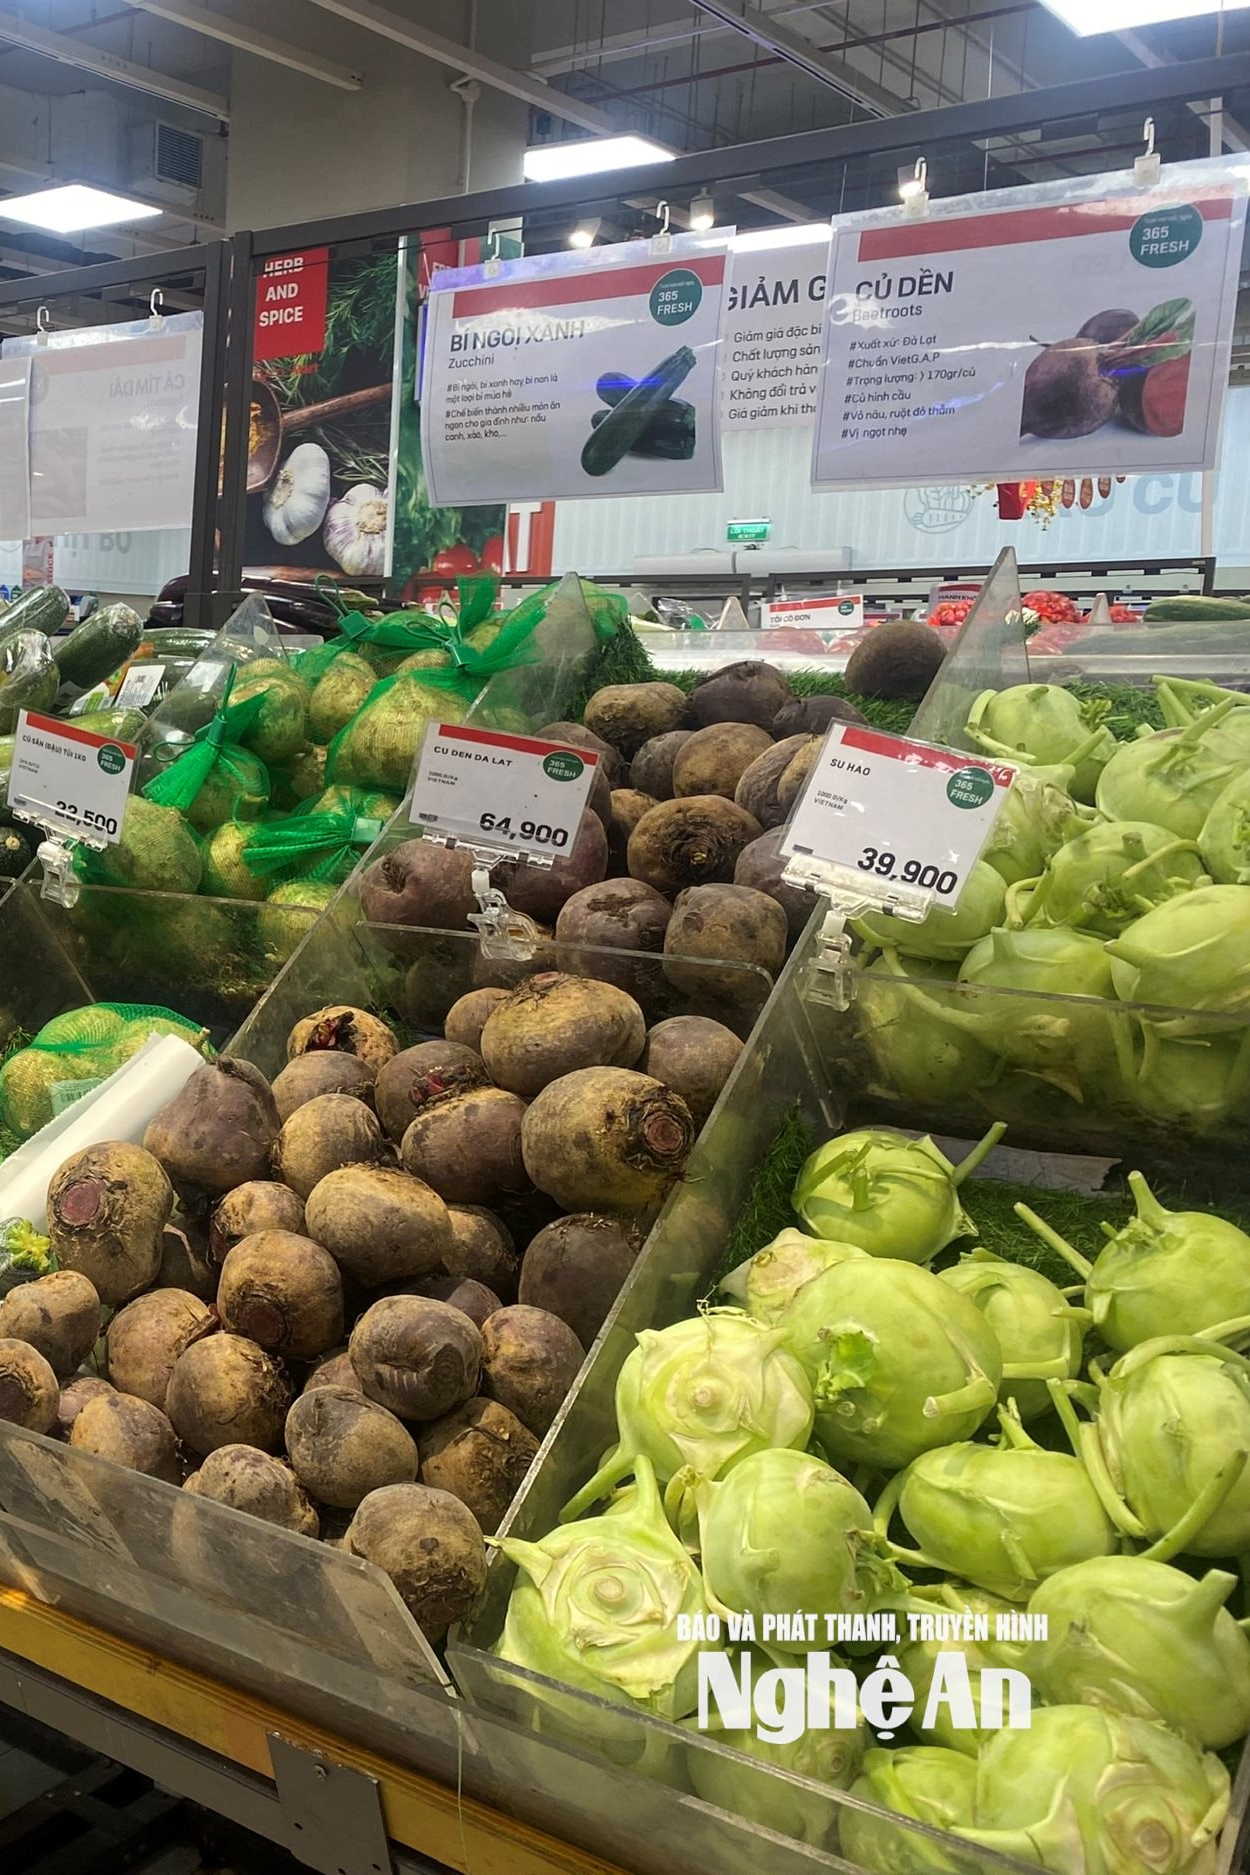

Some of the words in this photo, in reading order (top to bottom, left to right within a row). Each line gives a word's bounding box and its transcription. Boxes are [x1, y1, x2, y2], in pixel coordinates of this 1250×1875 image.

[1142, 226, 1170, 241] 365
[1140, 240, 1190, 257] FRESH
[262, 257, 304, 278] HERB
[265, 283, 299, 302] AND
[855, 272, 892, 301] CỦ
[897, 267, 954, 298] DỀN
[658, 290, 678, 302] 365
[259, 306, 304, 327] SPICE
[657, 301, 693, 316] FRESH
[450, 327, 469, 352] BÍ
[525, 320, 586, 345] XANH
[734, 330, 764, 343] Giảm
[766, 327, 784, 342] giá
[786, 325, 808, 339] đặc
[902, 335, 918, 346] Đà
[920, 335, 937, 346] Lạt
[448, 353, 495, 369] Zucchini
[732, 347, 761, 362] Chất
[763, 347, 797, 361] lượng
[799, 343, 821, 356] sản
[731, 370, 754, 382] Quý
[757, 366, 793, 379] khách
[730, 387, 767, 401] Không
[769, 383, 786, 397] đổi
[790, 382, 807, 395] trả
[728, 407, 748, 419] Giá
[750, 405, 778, 420] giảm
[780, 403, 799, 416] khi
[434, 746, 449, 755] CU
[451, 750, 473, 760] DEN
[474, 754, 489, 763] DA
[492, 757, 513, 767] LAT
[549, 759, 566, 769] 365
[547, 766, 577, 779] FRESH
[830, 758, 845, 769] SU
[846, 763, 871, 776] HAO
[954, 778, 973, 791] 365
[814, 798, 844, 810] VIETNAM
[950, 788, 983, 805] FRESH
[55, 801, 118, 835] 22,500
[479, 812, 569, 848] 64,900
[857, 847, 958, 895] 39,900
